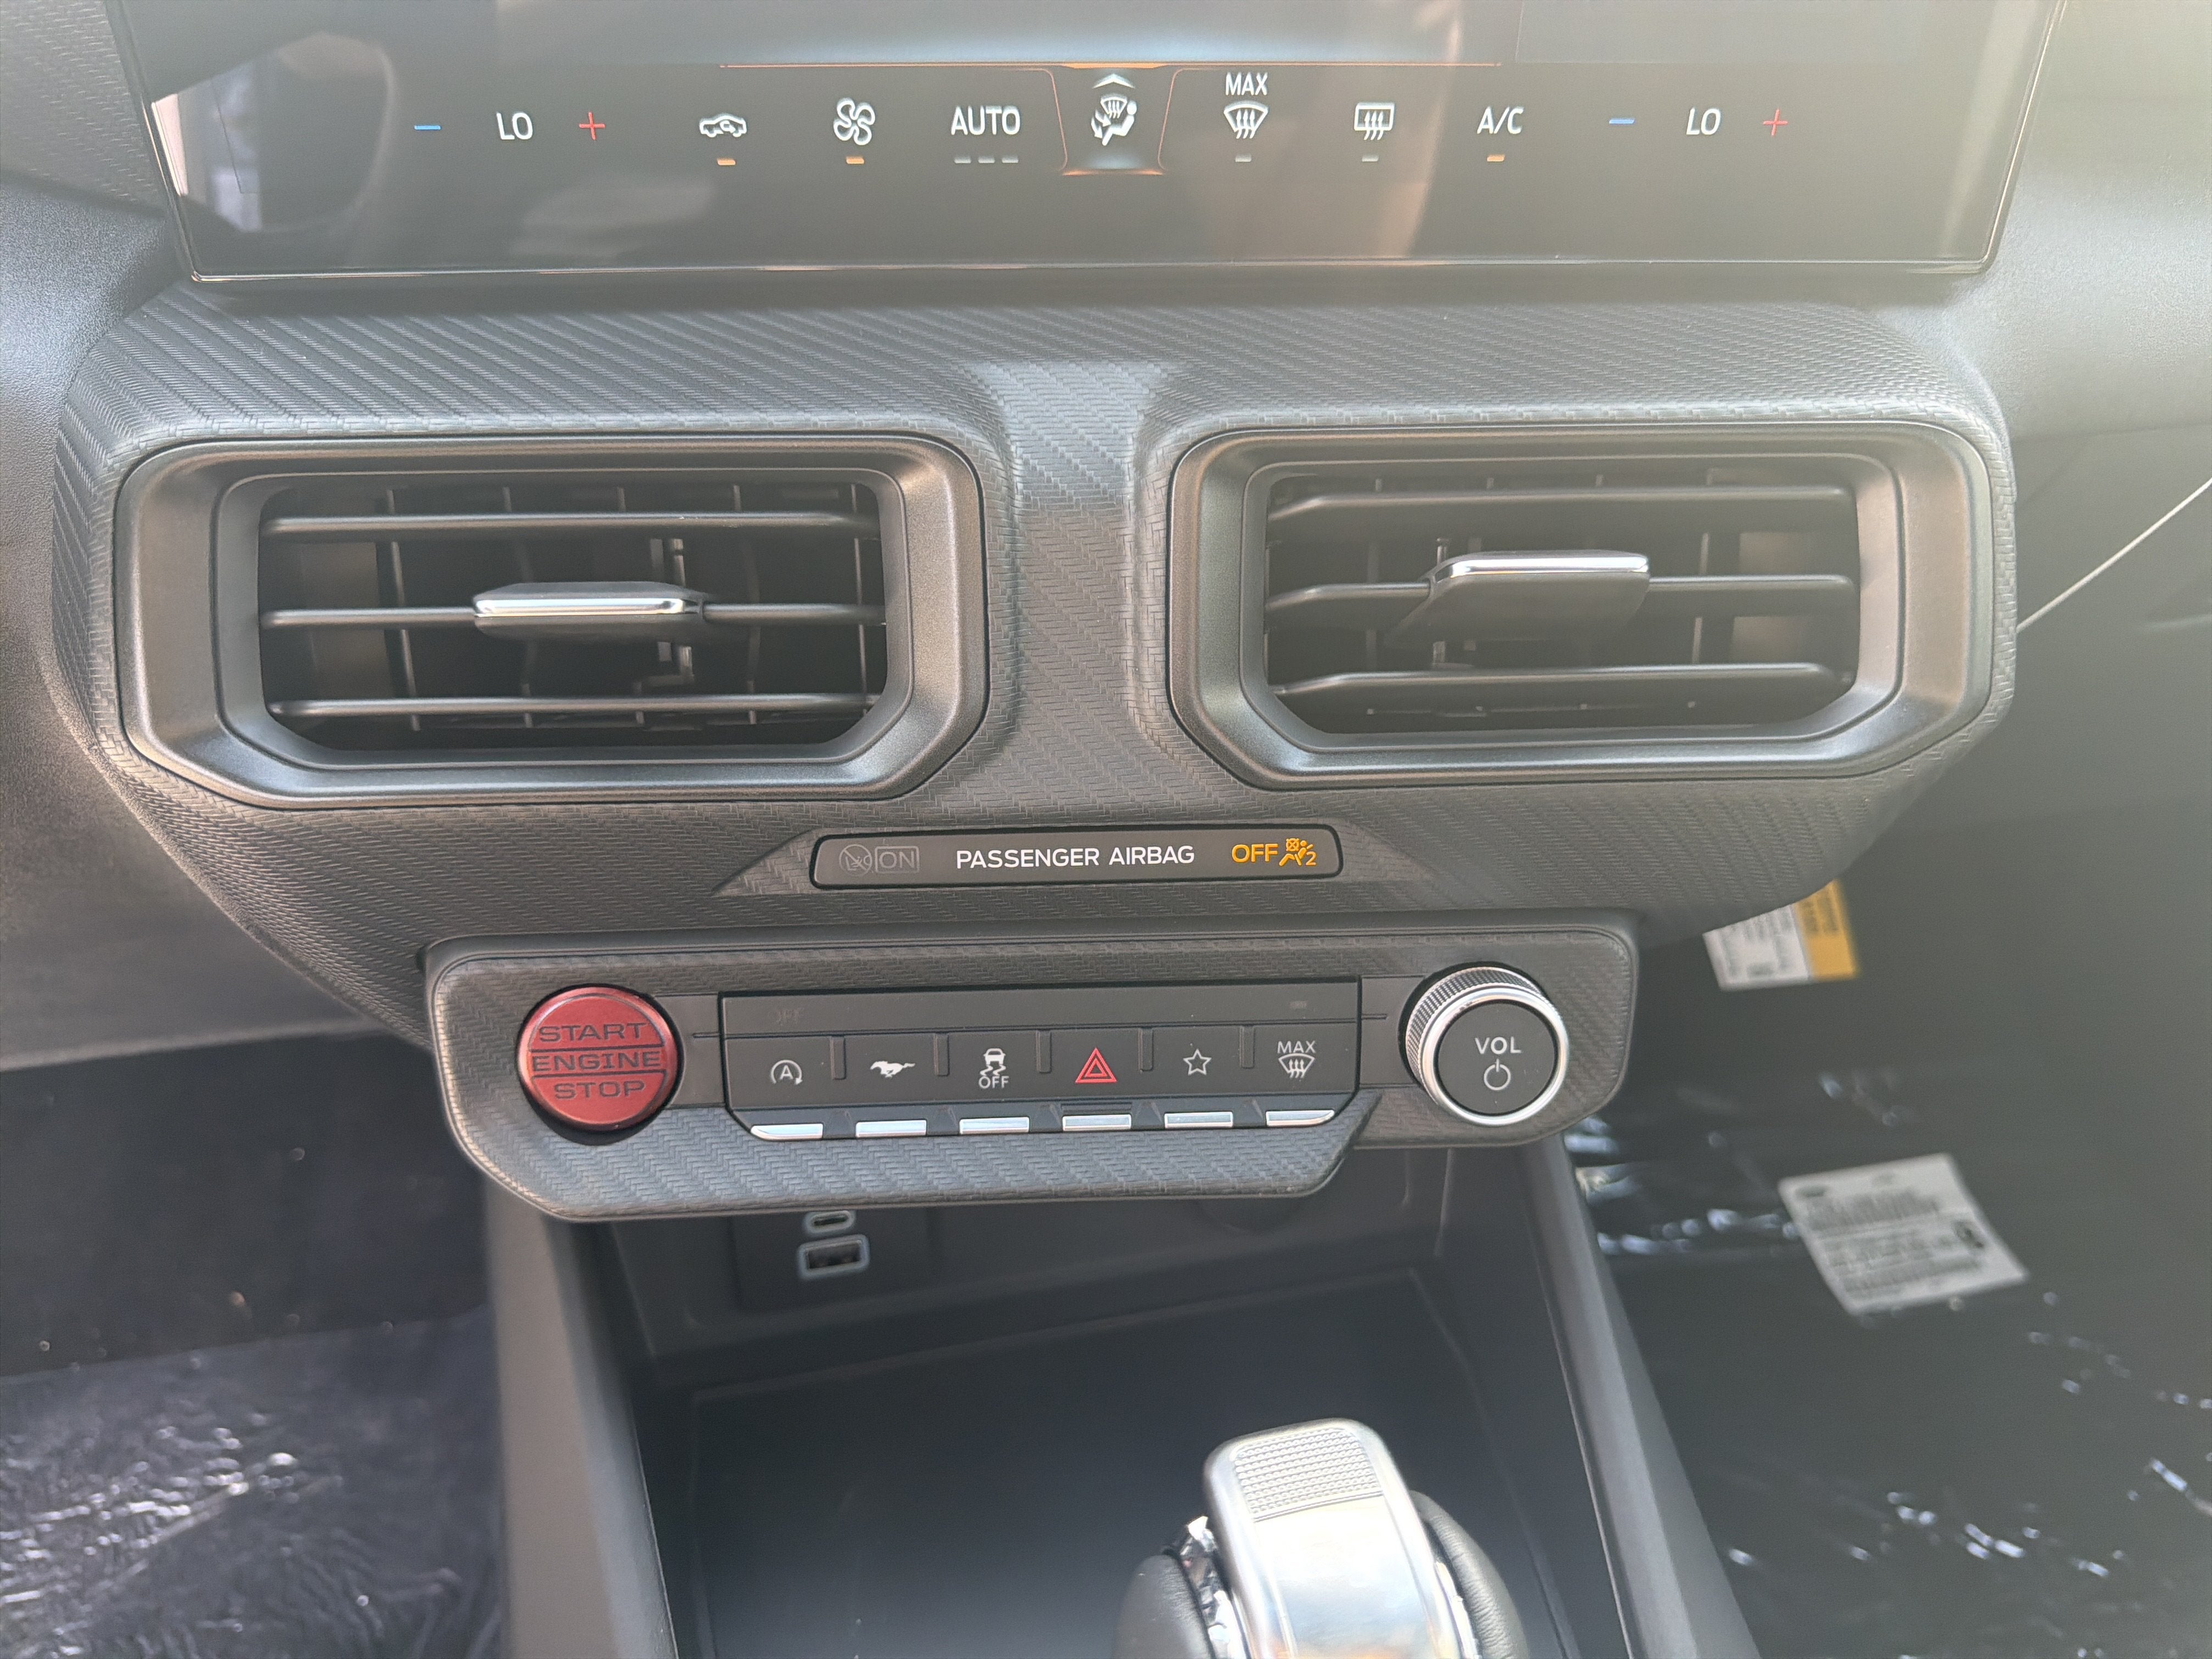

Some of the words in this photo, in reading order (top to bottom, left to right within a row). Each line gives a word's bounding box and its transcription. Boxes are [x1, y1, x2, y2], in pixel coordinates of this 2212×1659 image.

[1224, 72, 1269, 97] MAX
[496, 111, 534, 141] LO
[950, 105, 1021, 136] AUTO
[1476, 106, 1525, 136] A/C
[1685, 106, 1723, 136] LO
[878, 851, 915, 869] ON
[956, 848, 1100, 870] PASSENGER
[1108, 845, 1195, 866] AIRBAG
[1231, 843, 1279, 863] OFF
[539, 1022, 646, 1042] START
[1277, 1040, 1316, 1053] MAX
[1475, 1036, 1522, 1055] VOL
[532, 1051, 661, 1071] ENGINE
[554, 1080, 645, 1099] STOP
[978, 1075, 1009, 1089] OFF
